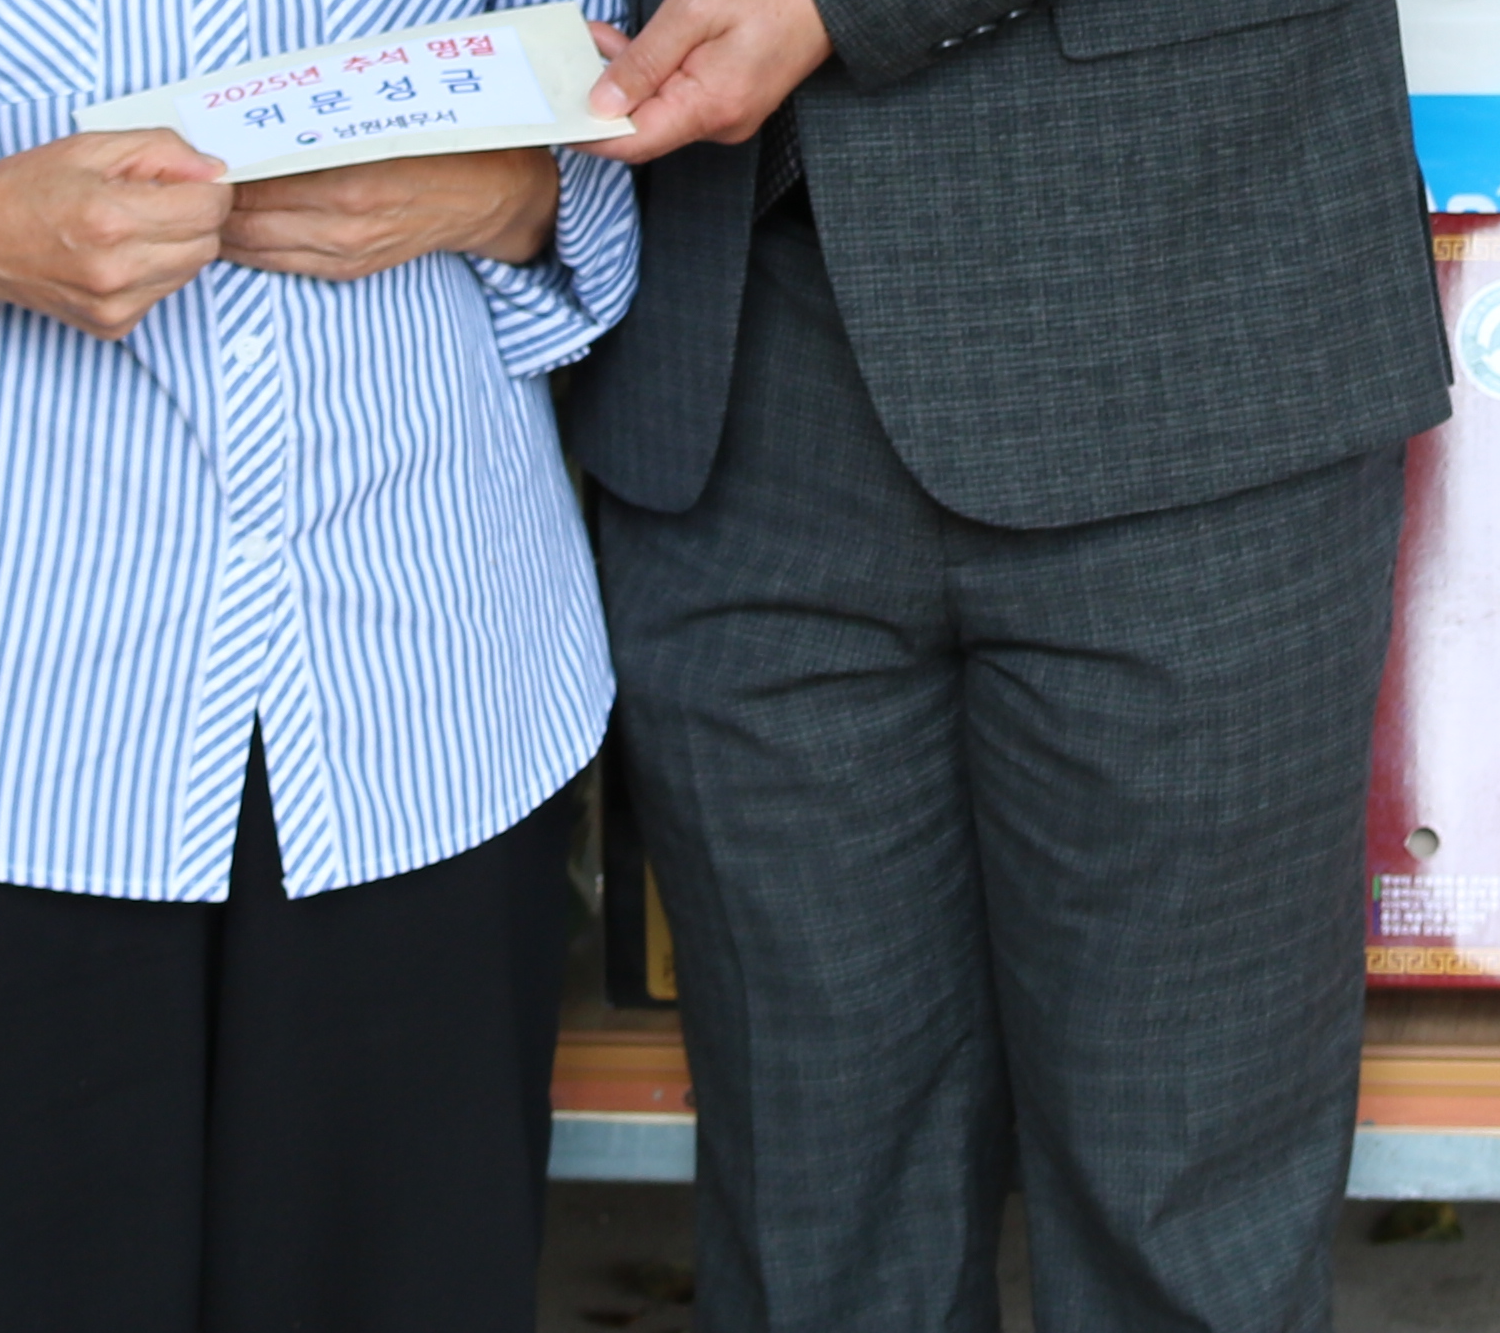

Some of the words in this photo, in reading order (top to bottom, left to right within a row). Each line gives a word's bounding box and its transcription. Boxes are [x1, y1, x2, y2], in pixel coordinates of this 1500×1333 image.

[204, 66, 321, 109] 2025년
[343, 46, 409, 74] 추석
[426, 35, 496, 60] 명절
[333, 110, 458, 139] 남원세무서
